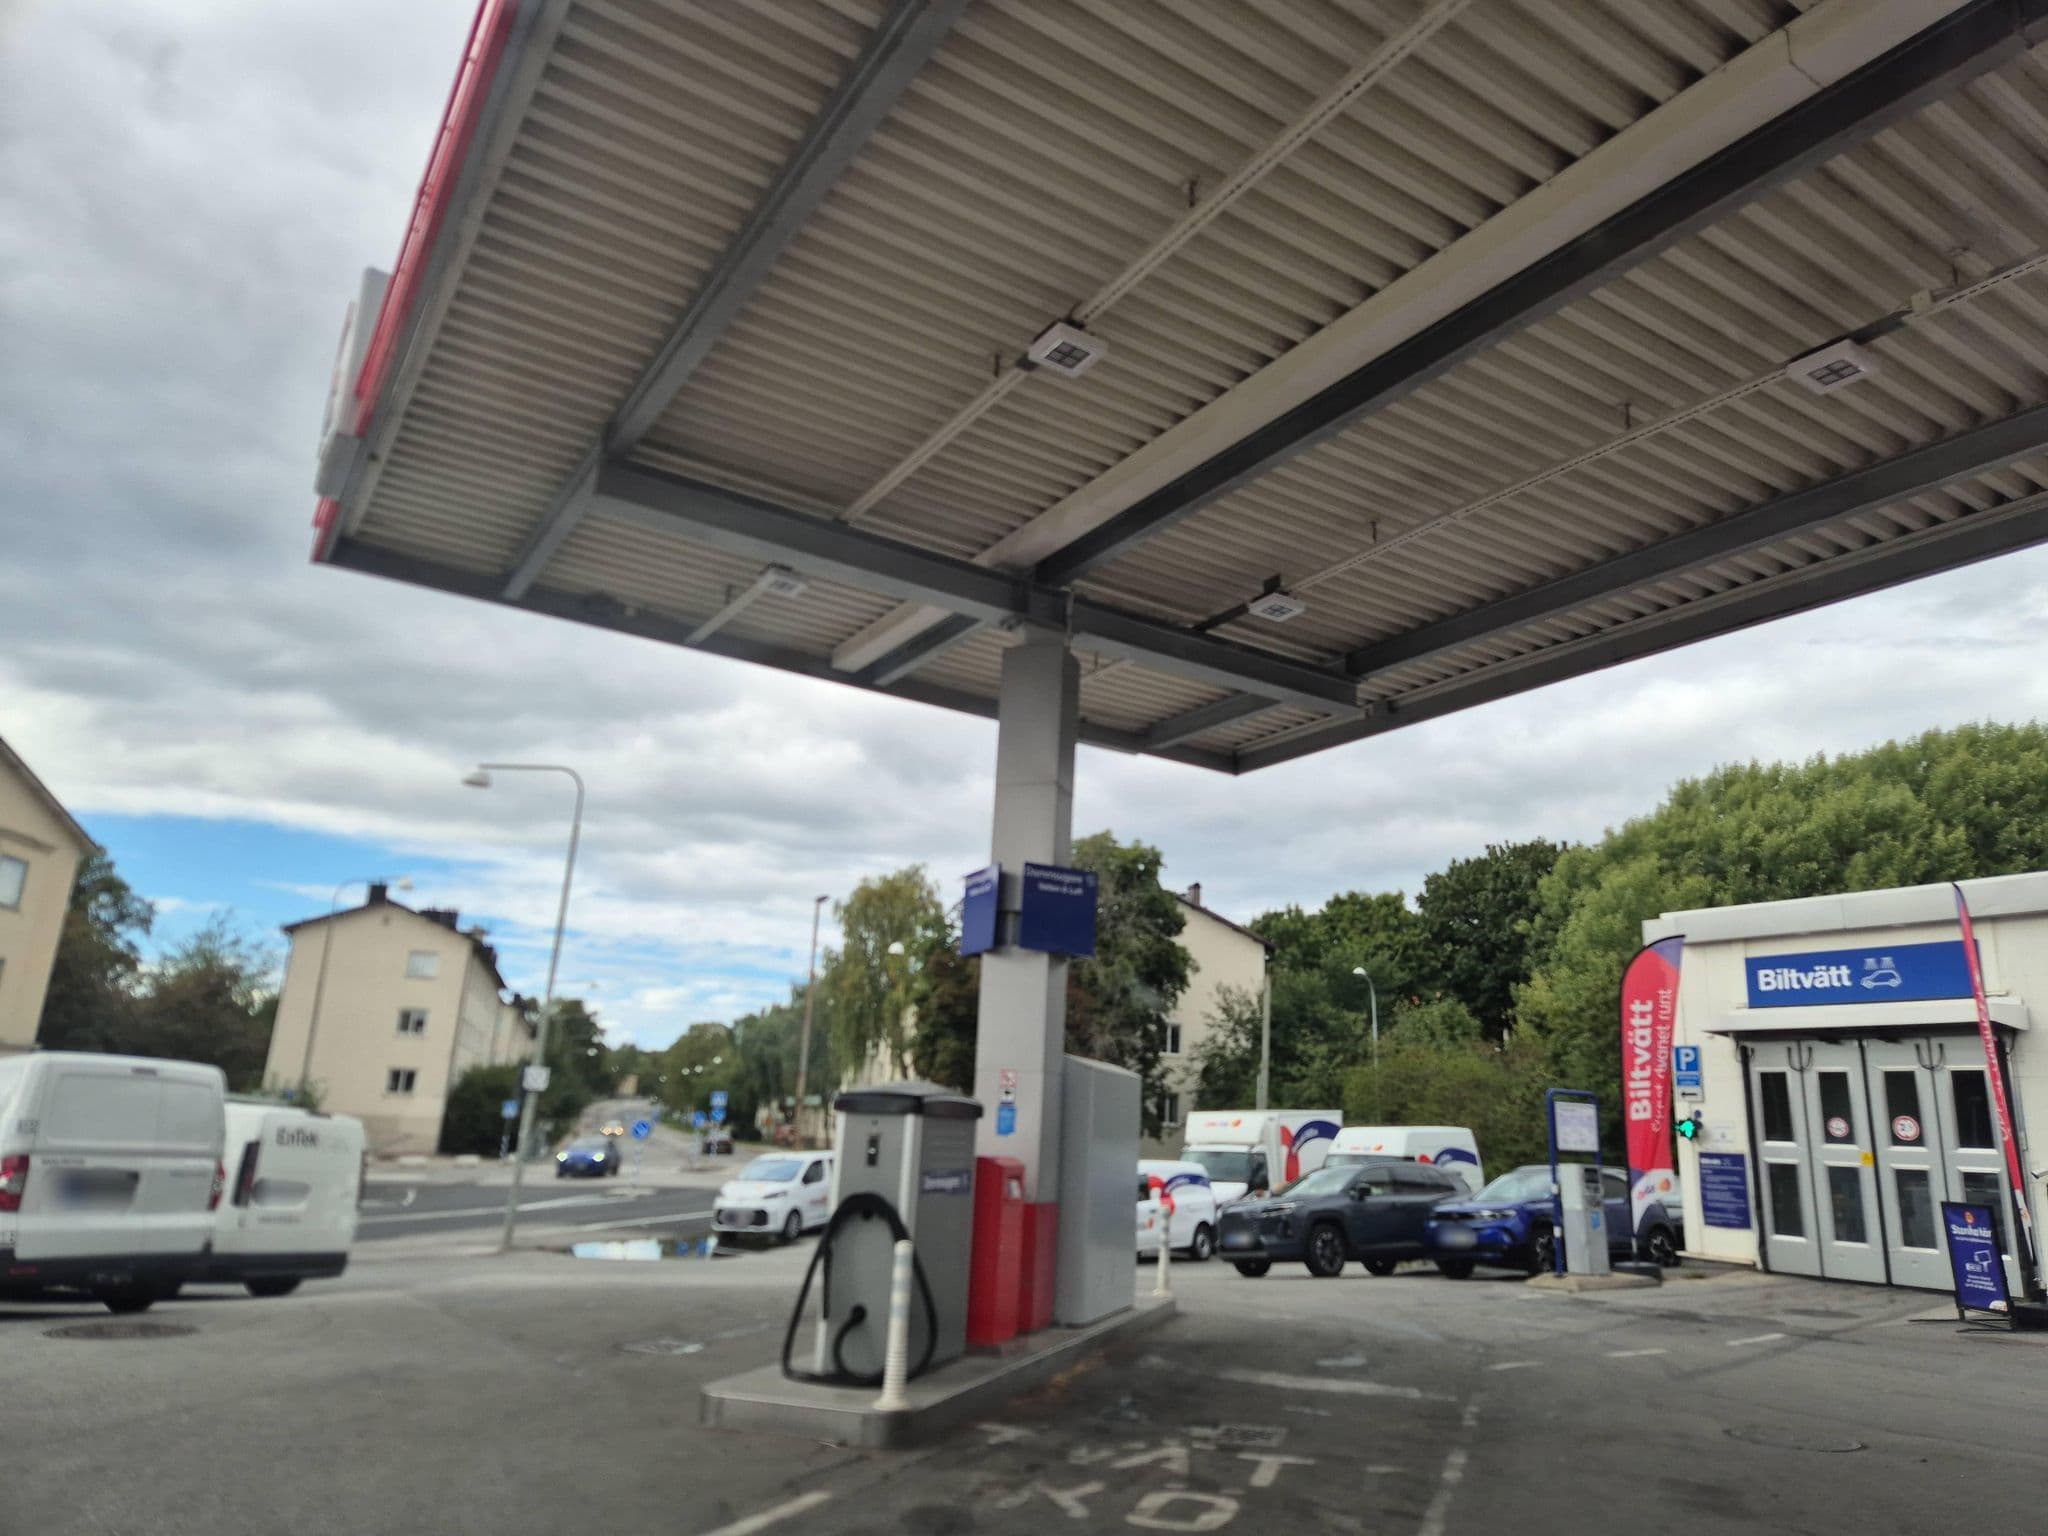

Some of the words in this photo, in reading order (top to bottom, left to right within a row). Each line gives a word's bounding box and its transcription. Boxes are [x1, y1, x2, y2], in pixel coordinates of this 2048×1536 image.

[1757, 965, 1852, 992] Biltvätt
[1656, 989, 1672, 1020] runt
[1628, 999, 1653, 1121] Biltvätt
[1680, 1048, 1696, 1071] P
